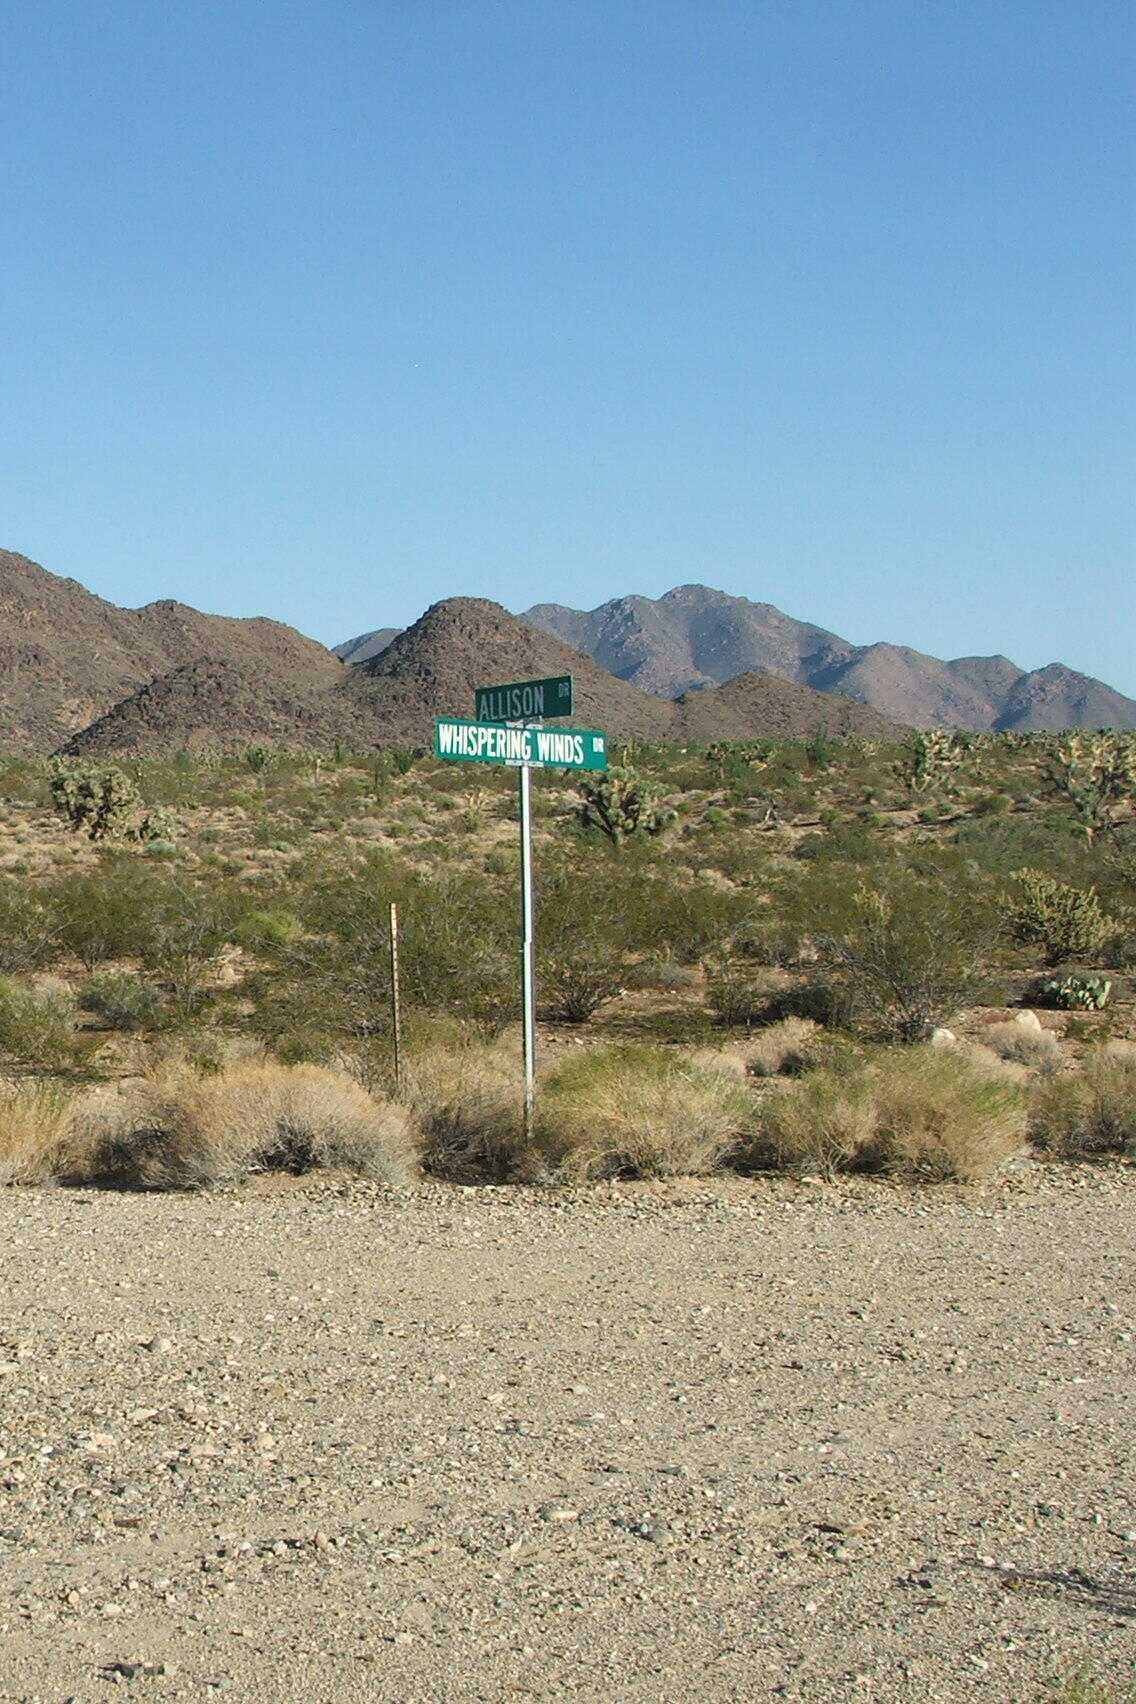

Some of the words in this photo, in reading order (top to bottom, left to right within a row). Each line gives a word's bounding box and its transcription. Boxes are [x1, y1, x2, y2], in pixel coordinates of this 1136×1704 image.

[479, 686, 545, 721] ALLISON
[558, 682, 570, 698] DR
[439, 724, 531, 760] WHISPERING
[537, 732, 584, 764] WINDS
[592, 737, 604, 752] DR
